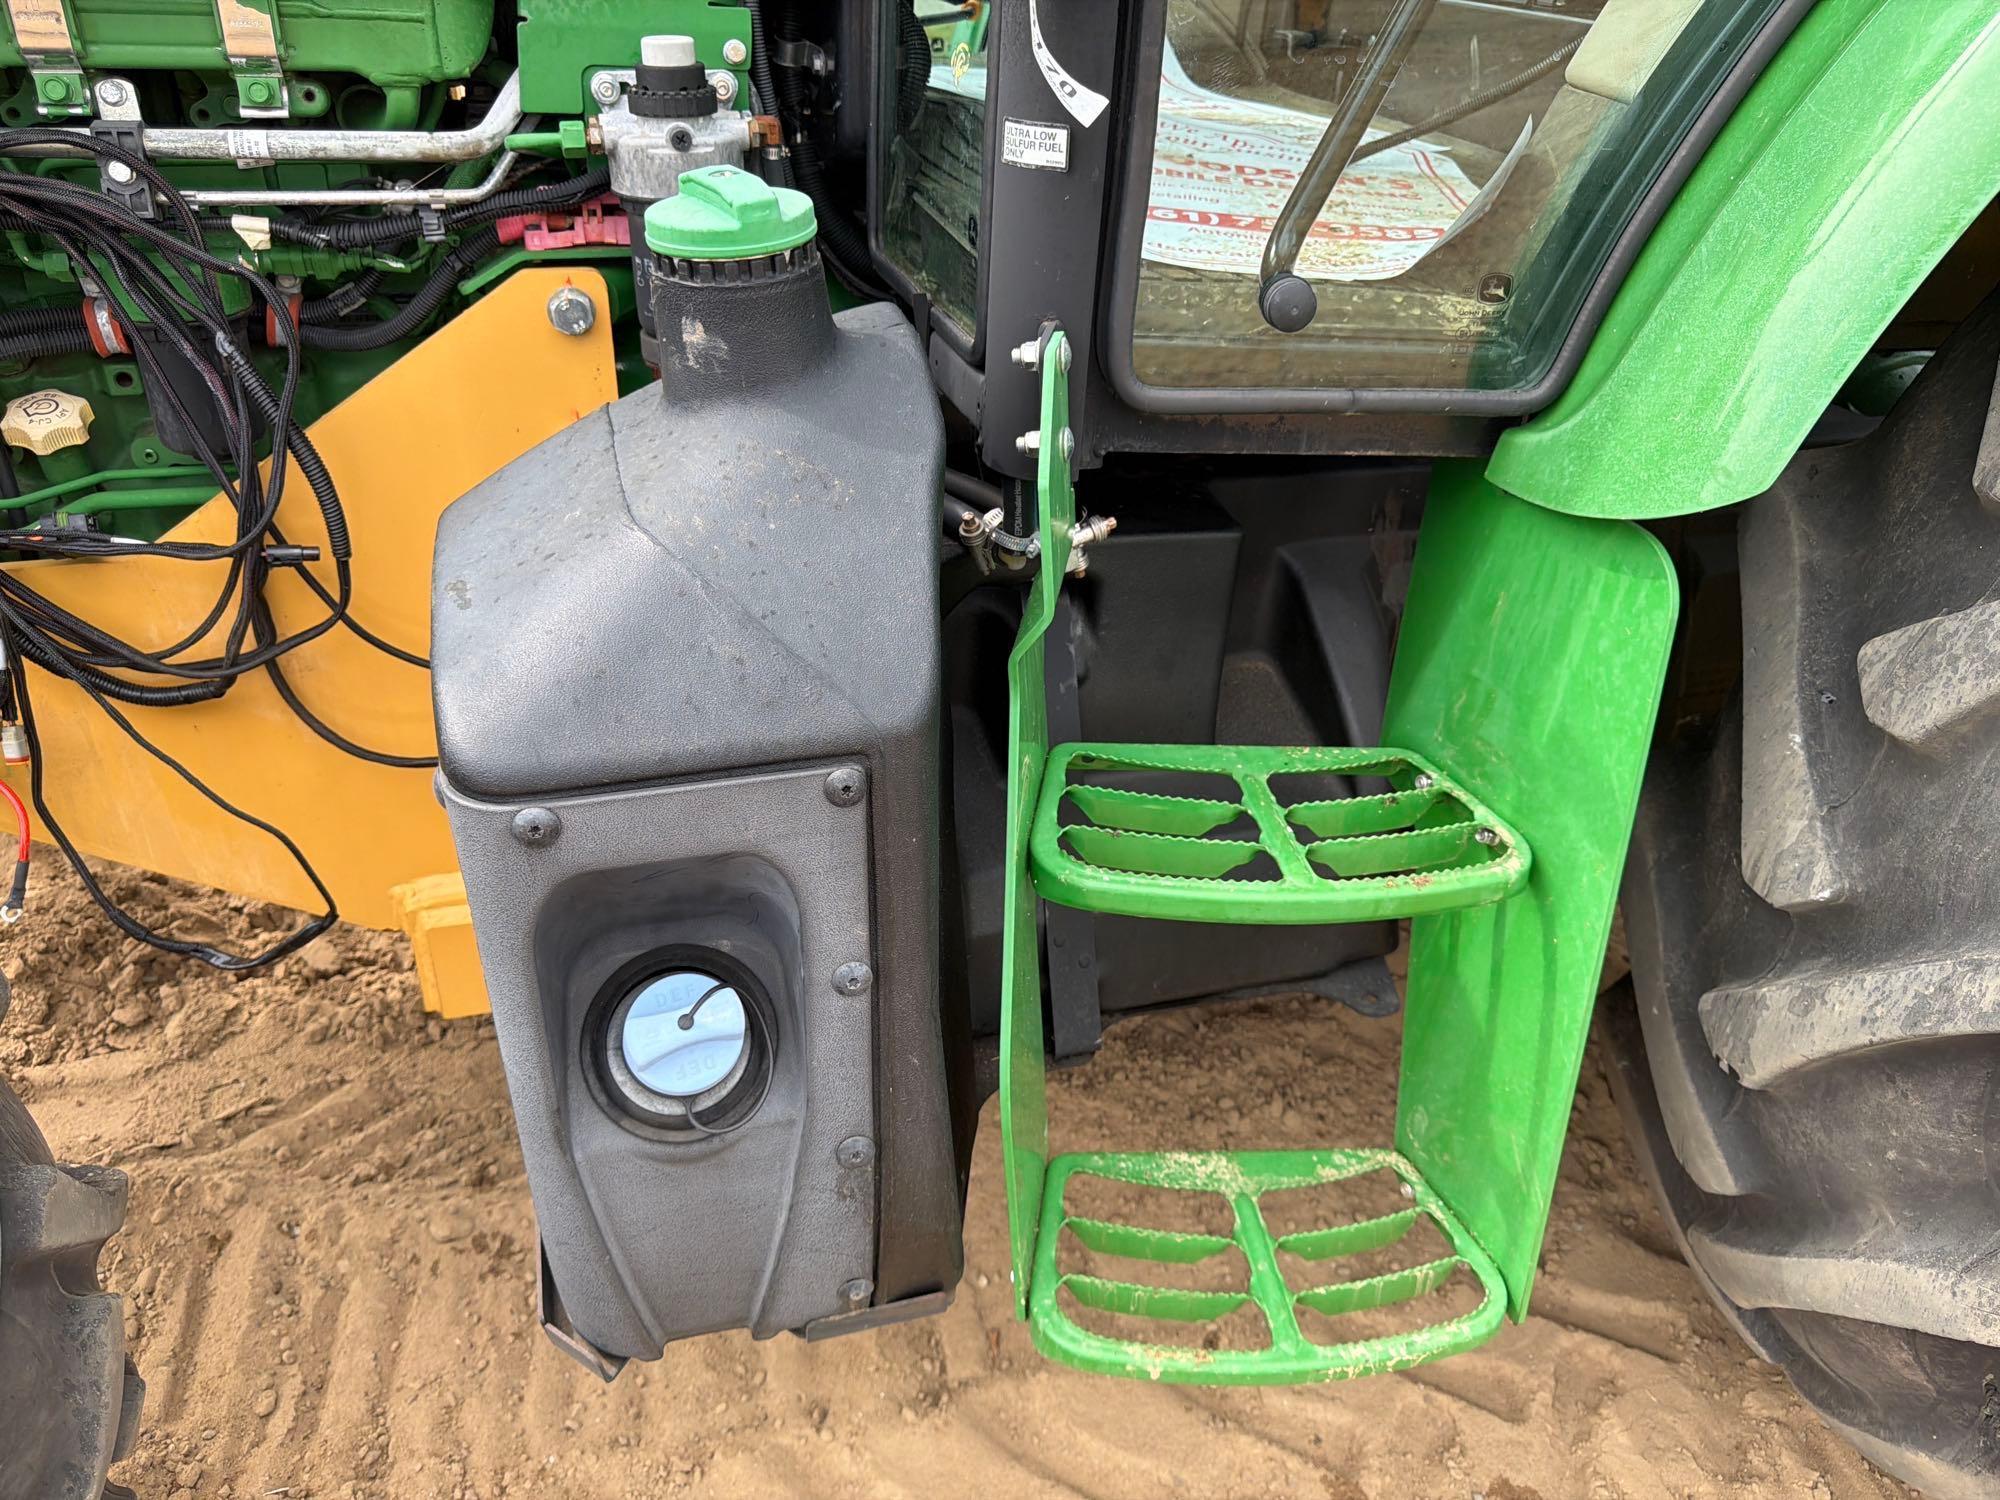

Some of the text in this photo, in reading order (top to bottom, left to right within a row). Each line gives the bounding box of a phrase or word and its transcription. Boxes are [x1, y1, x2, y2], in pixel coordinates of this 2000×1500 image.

[1006, 126, 1057, 142] ULTRA LOW
[1005, 146, 1024, 159] ONLY
[1006, 136, 1064, 154] SULFUR FUEL
[654, 983, 697, 1008] DEF
[676, 1054, 717, 1081] DEF
